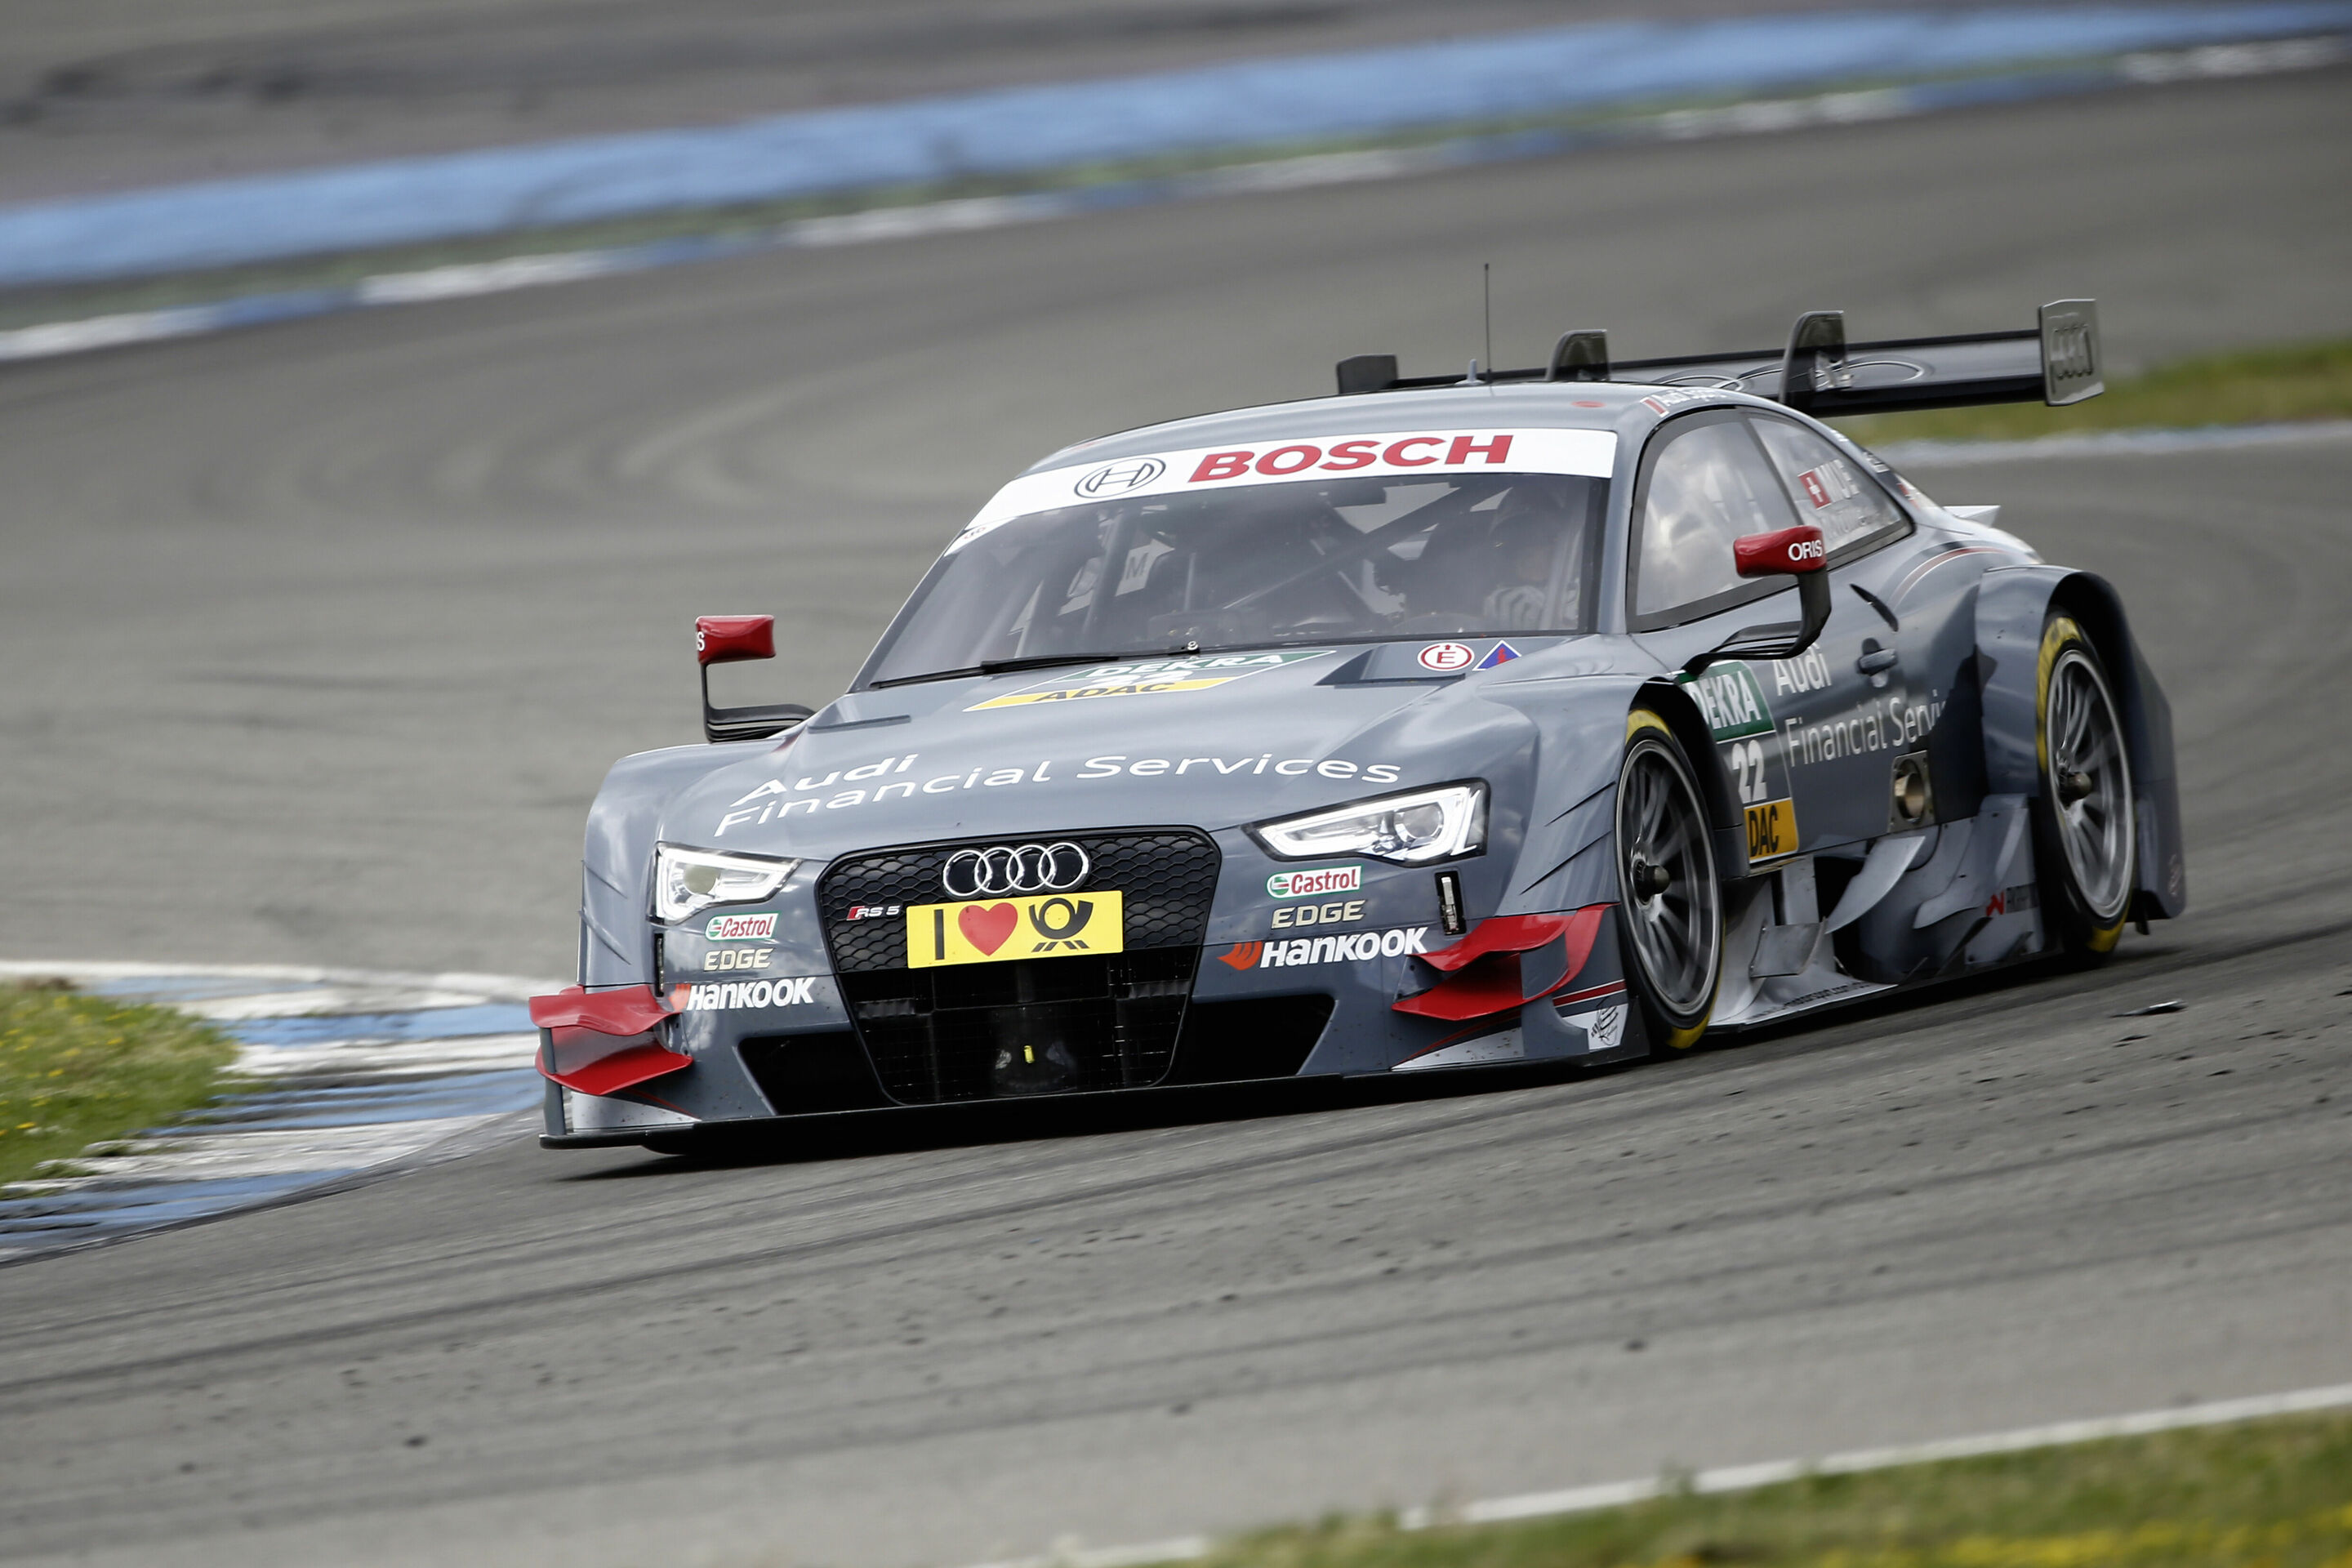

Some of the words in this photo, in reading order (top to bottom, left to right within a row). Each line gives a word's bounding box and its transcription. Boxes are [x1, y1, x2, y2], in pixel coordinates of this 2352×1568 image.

[1187, 434, 1514, 483] BOSCH
[1788, 540, 1824, 561] ORIS
[1085, 654, 1284, 677] DEKRA
[1774, 642, 1832, 696] Audi
[1032, 683, 1178, 702] ADAC
[1682, 670, 1762, 730] DEKRA
[1784, 700, 1887, 768] Financial
[714, 760, 1052, 837] Financial
[1076, 753, 1402, 784] Services
[729, 754, 919, 808] Audi
[1731, 739, 1767, 804] 22
[1748, 804, 1780, 858] DAC
[1291, 868, 1358, 894] Castrol
[722, 915, 773, 938] Castrol
[1272, 899, 1366, 929] EDGE
[704, 947, 774, 972] EDGE
